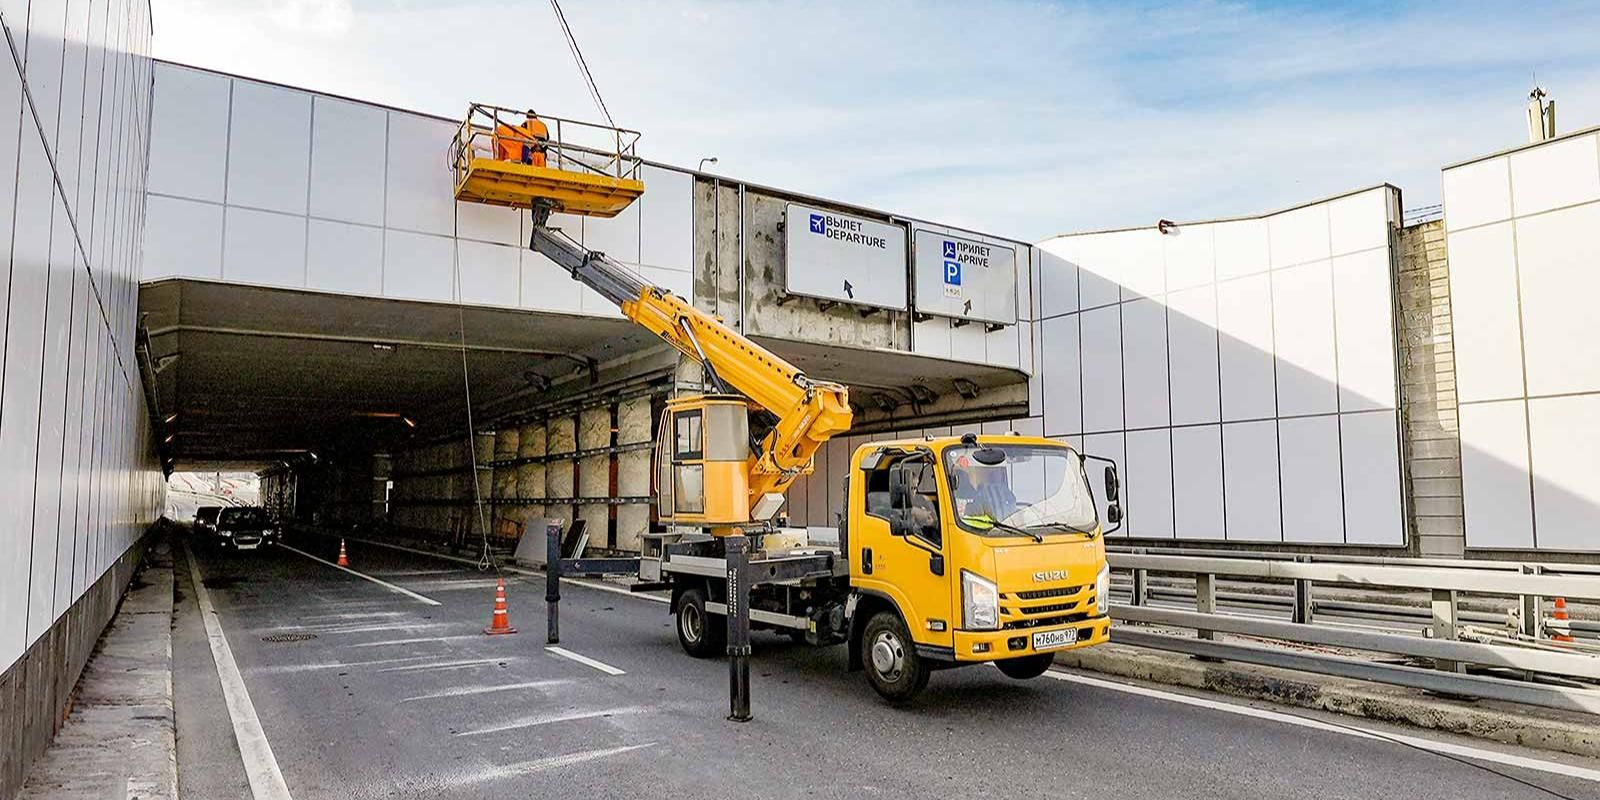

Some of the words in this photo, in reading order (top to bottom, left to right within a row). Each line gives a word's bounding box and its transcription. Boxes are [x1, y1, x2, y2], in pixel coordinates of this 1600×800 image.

[826, 216, 862, 232] ВЫЛЕТ
[826, 228, 886, 249] DEPARTURE
[957, 241, 991, 257] ПРИЛЕТ
[957, 253, 989, 268] APRIVE
[1032, 569, 1069, 582] ISUZU
